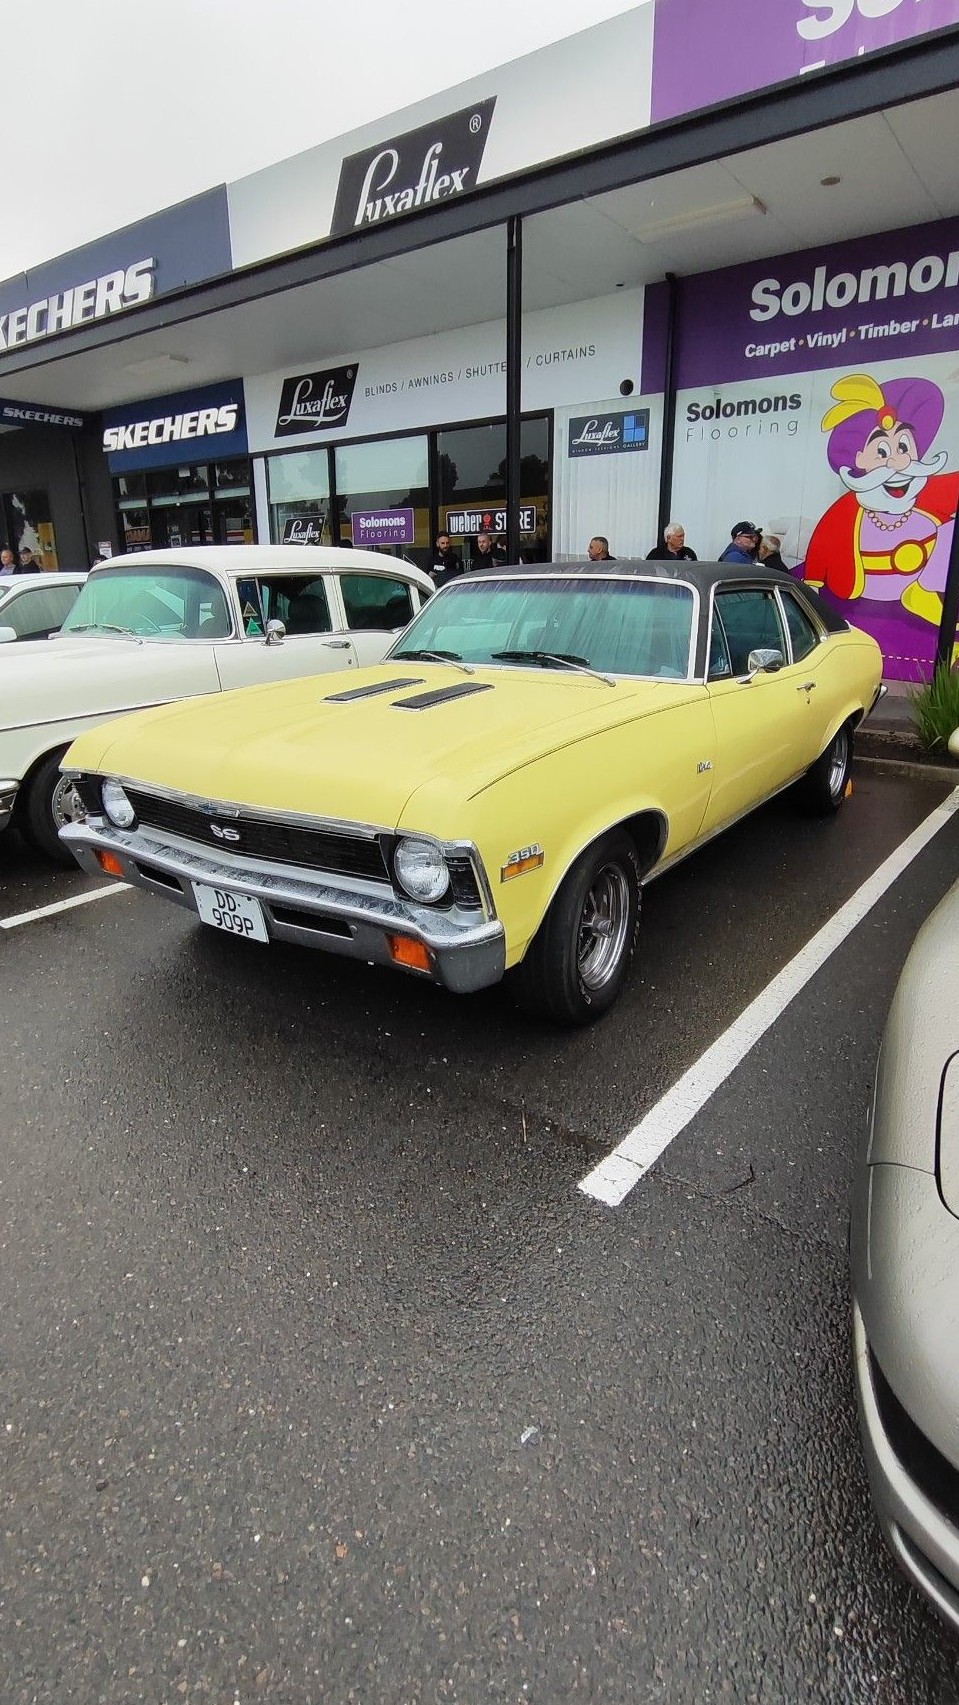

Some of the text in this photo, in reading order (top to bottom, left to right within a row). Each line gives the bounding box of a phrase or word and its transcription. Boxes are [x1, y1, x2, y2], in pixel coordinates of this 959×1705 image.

[353, 142, 470, 227] Luxaflex
[745, 337, 796, 358] Carpet
[806, 328, 847, 348] Vinyl
[858, 318, 920, 341] Timber
[365, 382, 398, 397] BLINDS
[408, 371, 454, 390] AWNINGS
[465, 361, 508, 379] SHUTTE
[535, 344, 596, 366] CURTAINS
[278, 378, 349, 427] Luxaflex
[686, 393, 802, 422] Solomons
[3, 407, 84, 427] SKECHERS
[102, 403, 238, 452] SKECHERS
[572, 419, 621, 446] Luxaflex
[686, 420, 799, 442] Flooring
[284, 519, 321, 546] Luxaflex
[359, 516, 406, 529] Solomons
[360, 528, 406, 539] Flooring
[449, 510, 532, 533] weber STRE
[210, 824, 240, 841] SS
[507, 843, 540, 864] 350
[212, 908, 254, 936] 909P
